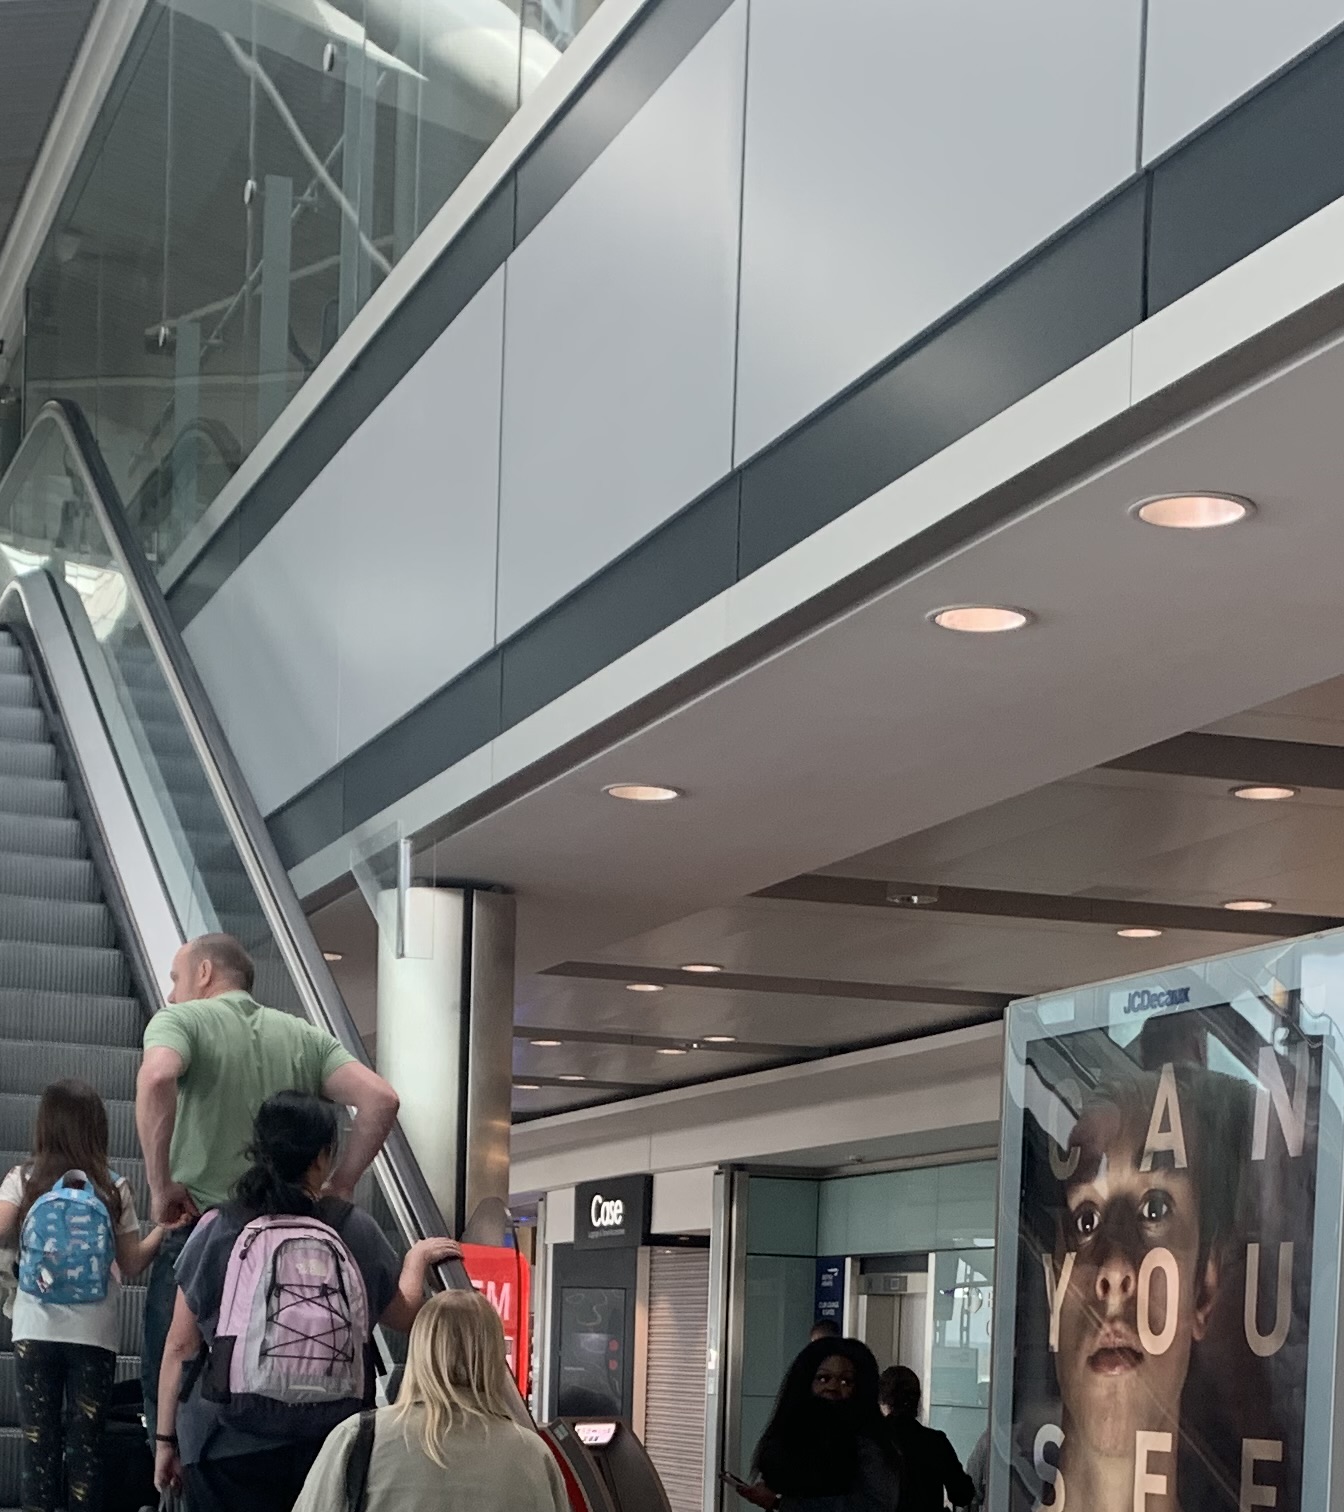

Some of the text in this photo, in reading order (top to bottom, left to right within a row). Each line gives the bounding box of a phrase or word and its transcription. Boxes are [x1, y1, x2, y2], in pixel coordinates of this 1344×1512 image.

[1047, 1040, 1309, 1181] CAN
[590, 1194, 623, 1228] Case
[471, 1279, 511, 1321] M
[1042, 1241, 1294, 1357] YOU
